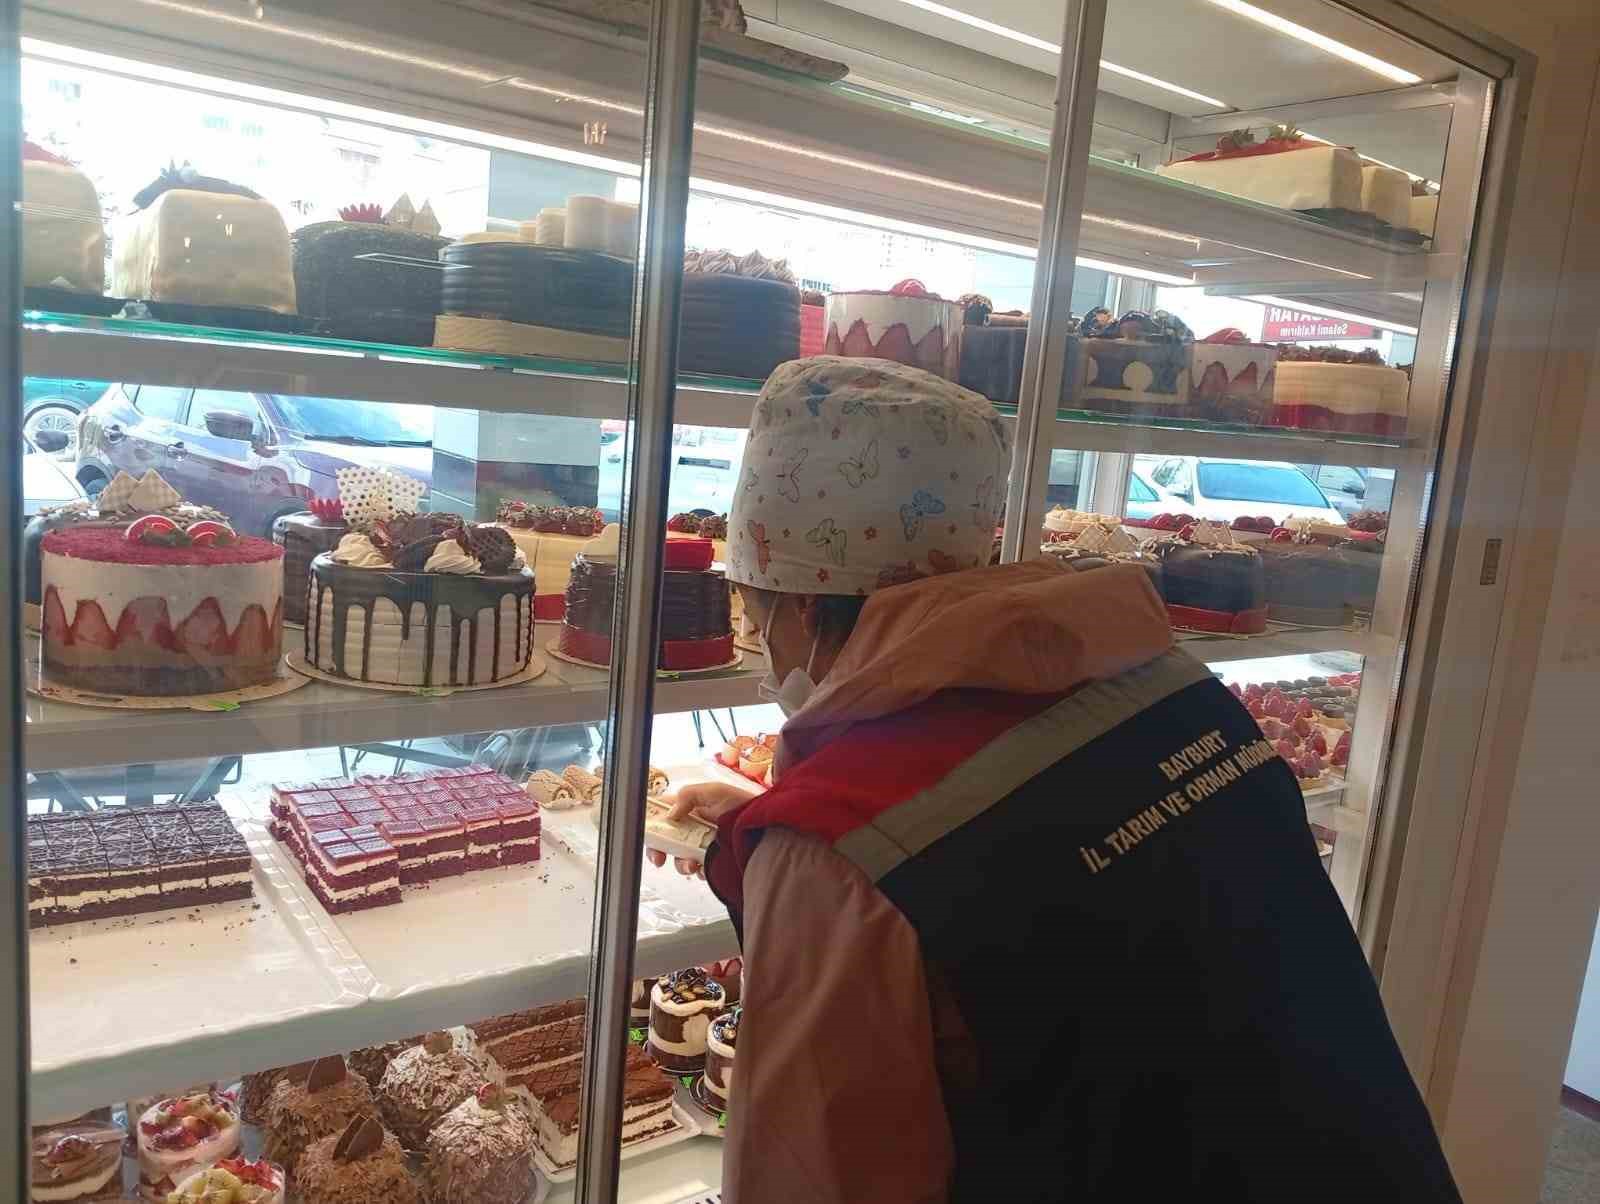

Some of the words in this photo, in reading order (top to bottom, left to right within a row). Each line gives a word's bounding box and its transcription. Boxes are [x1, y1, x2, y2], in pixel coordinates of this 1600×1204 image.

[1158, 729, 1227, 782] BAYBURT
[1079, 847, 1111, 873] İL
[1103, 805, 1168, 855] TARIM
[1159, 791, 1191, 816] VE
[1185, 759, 1242, 802] ORMAN
